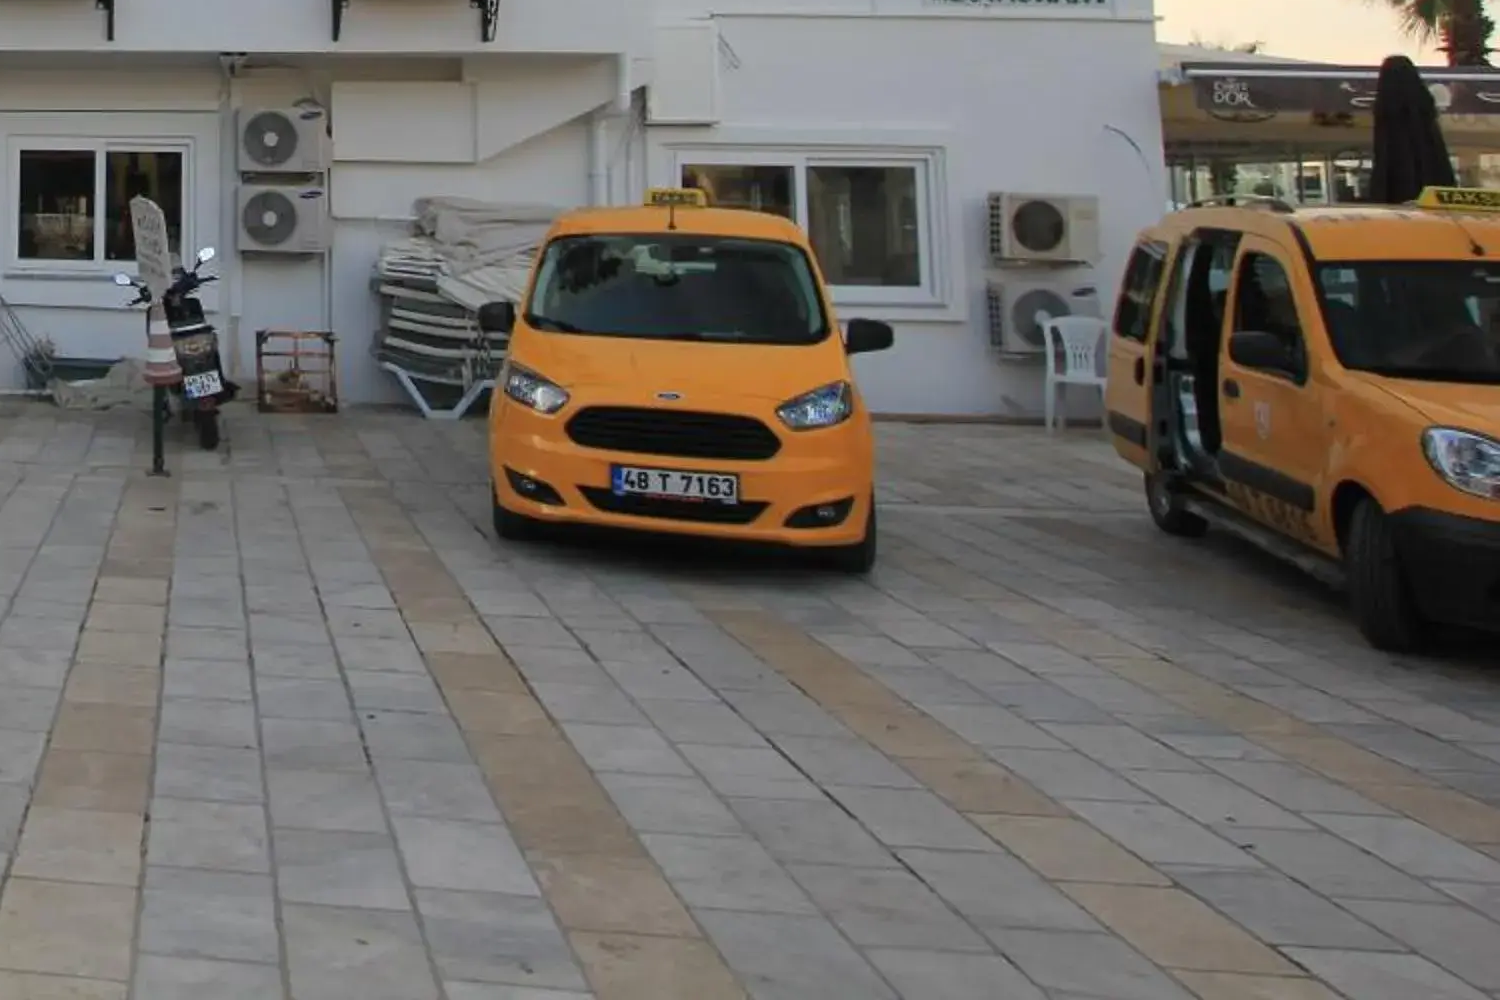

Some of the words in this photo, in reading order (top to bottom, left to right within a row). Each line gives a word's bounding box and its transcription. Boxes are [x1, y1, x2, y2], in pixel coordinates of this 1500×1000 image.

[625, 471, 649, 490] 48
[658, 473, 671, 492] T
[681, 475, 735, 497] 7163
